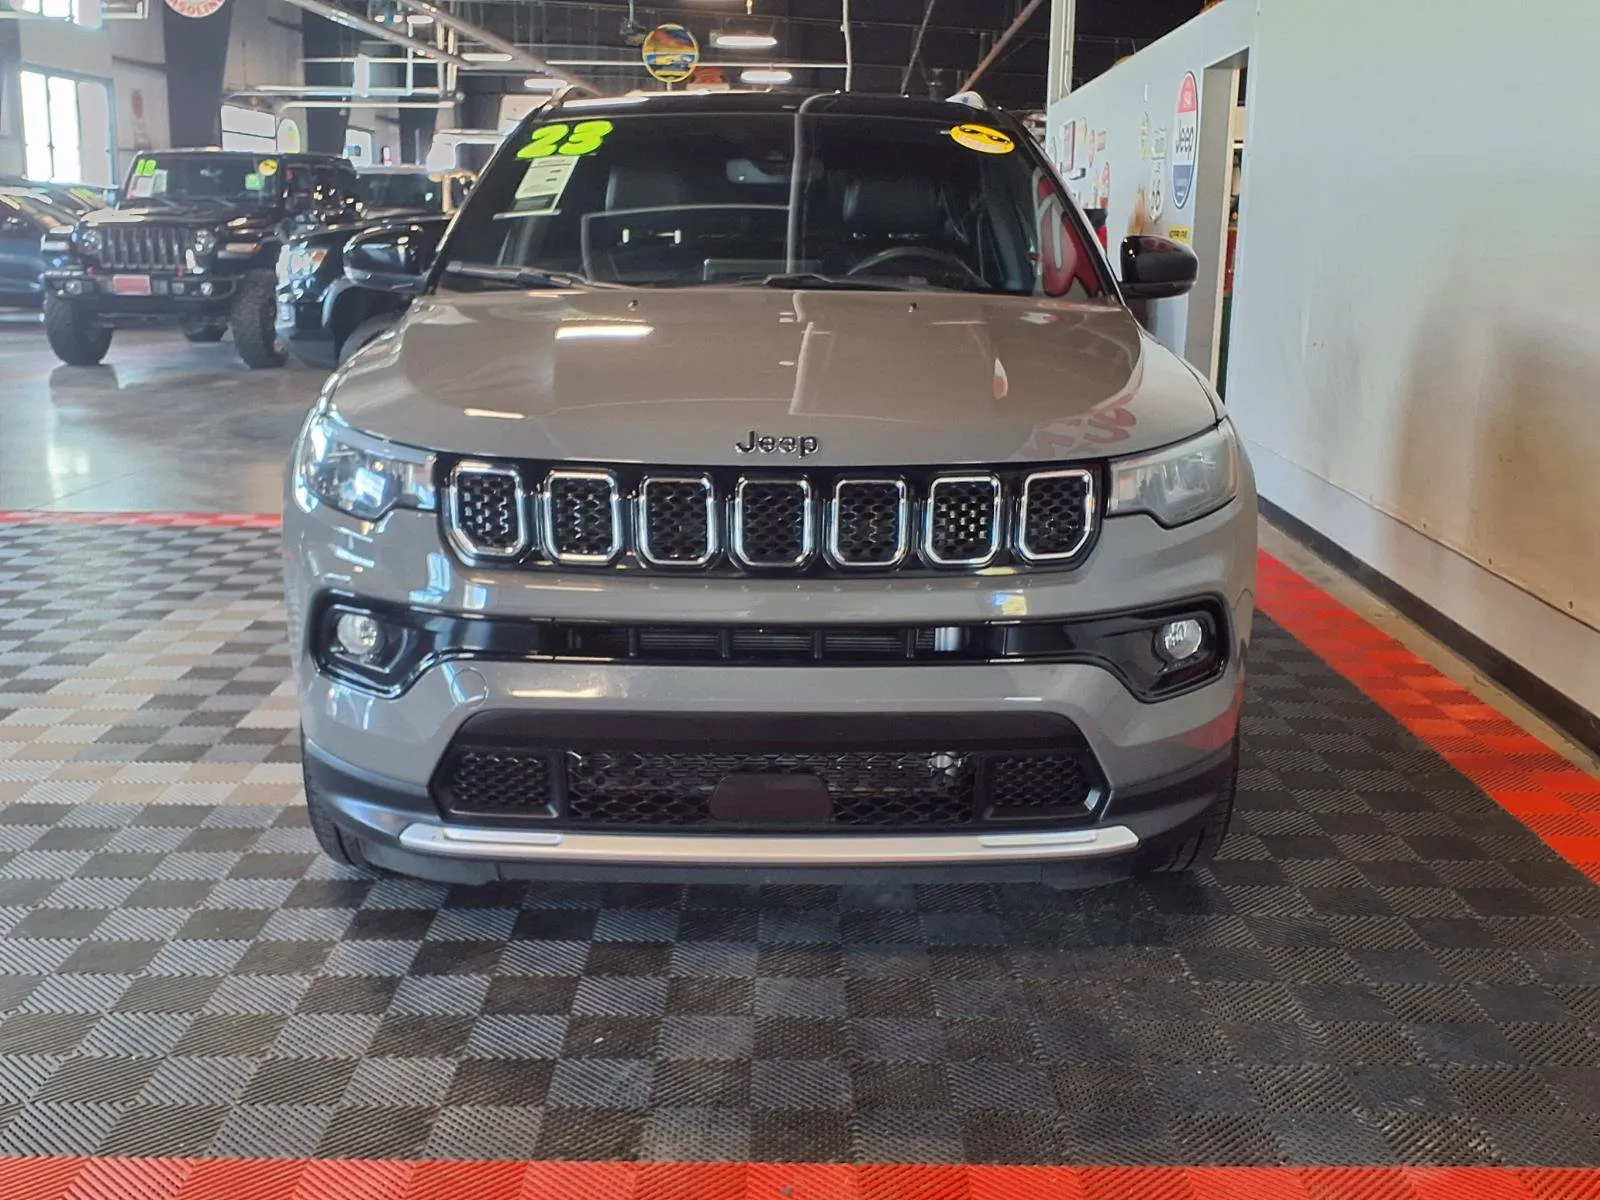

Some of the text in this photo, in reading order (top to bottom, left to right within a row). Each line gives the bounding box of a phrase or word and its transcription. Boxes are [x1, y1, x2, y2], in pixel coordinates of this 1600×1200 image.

[516, 120, 613, 158] 23
[1175, 119, 1194, 160] Jeep
[735, 430, 818, 459] Jeep
